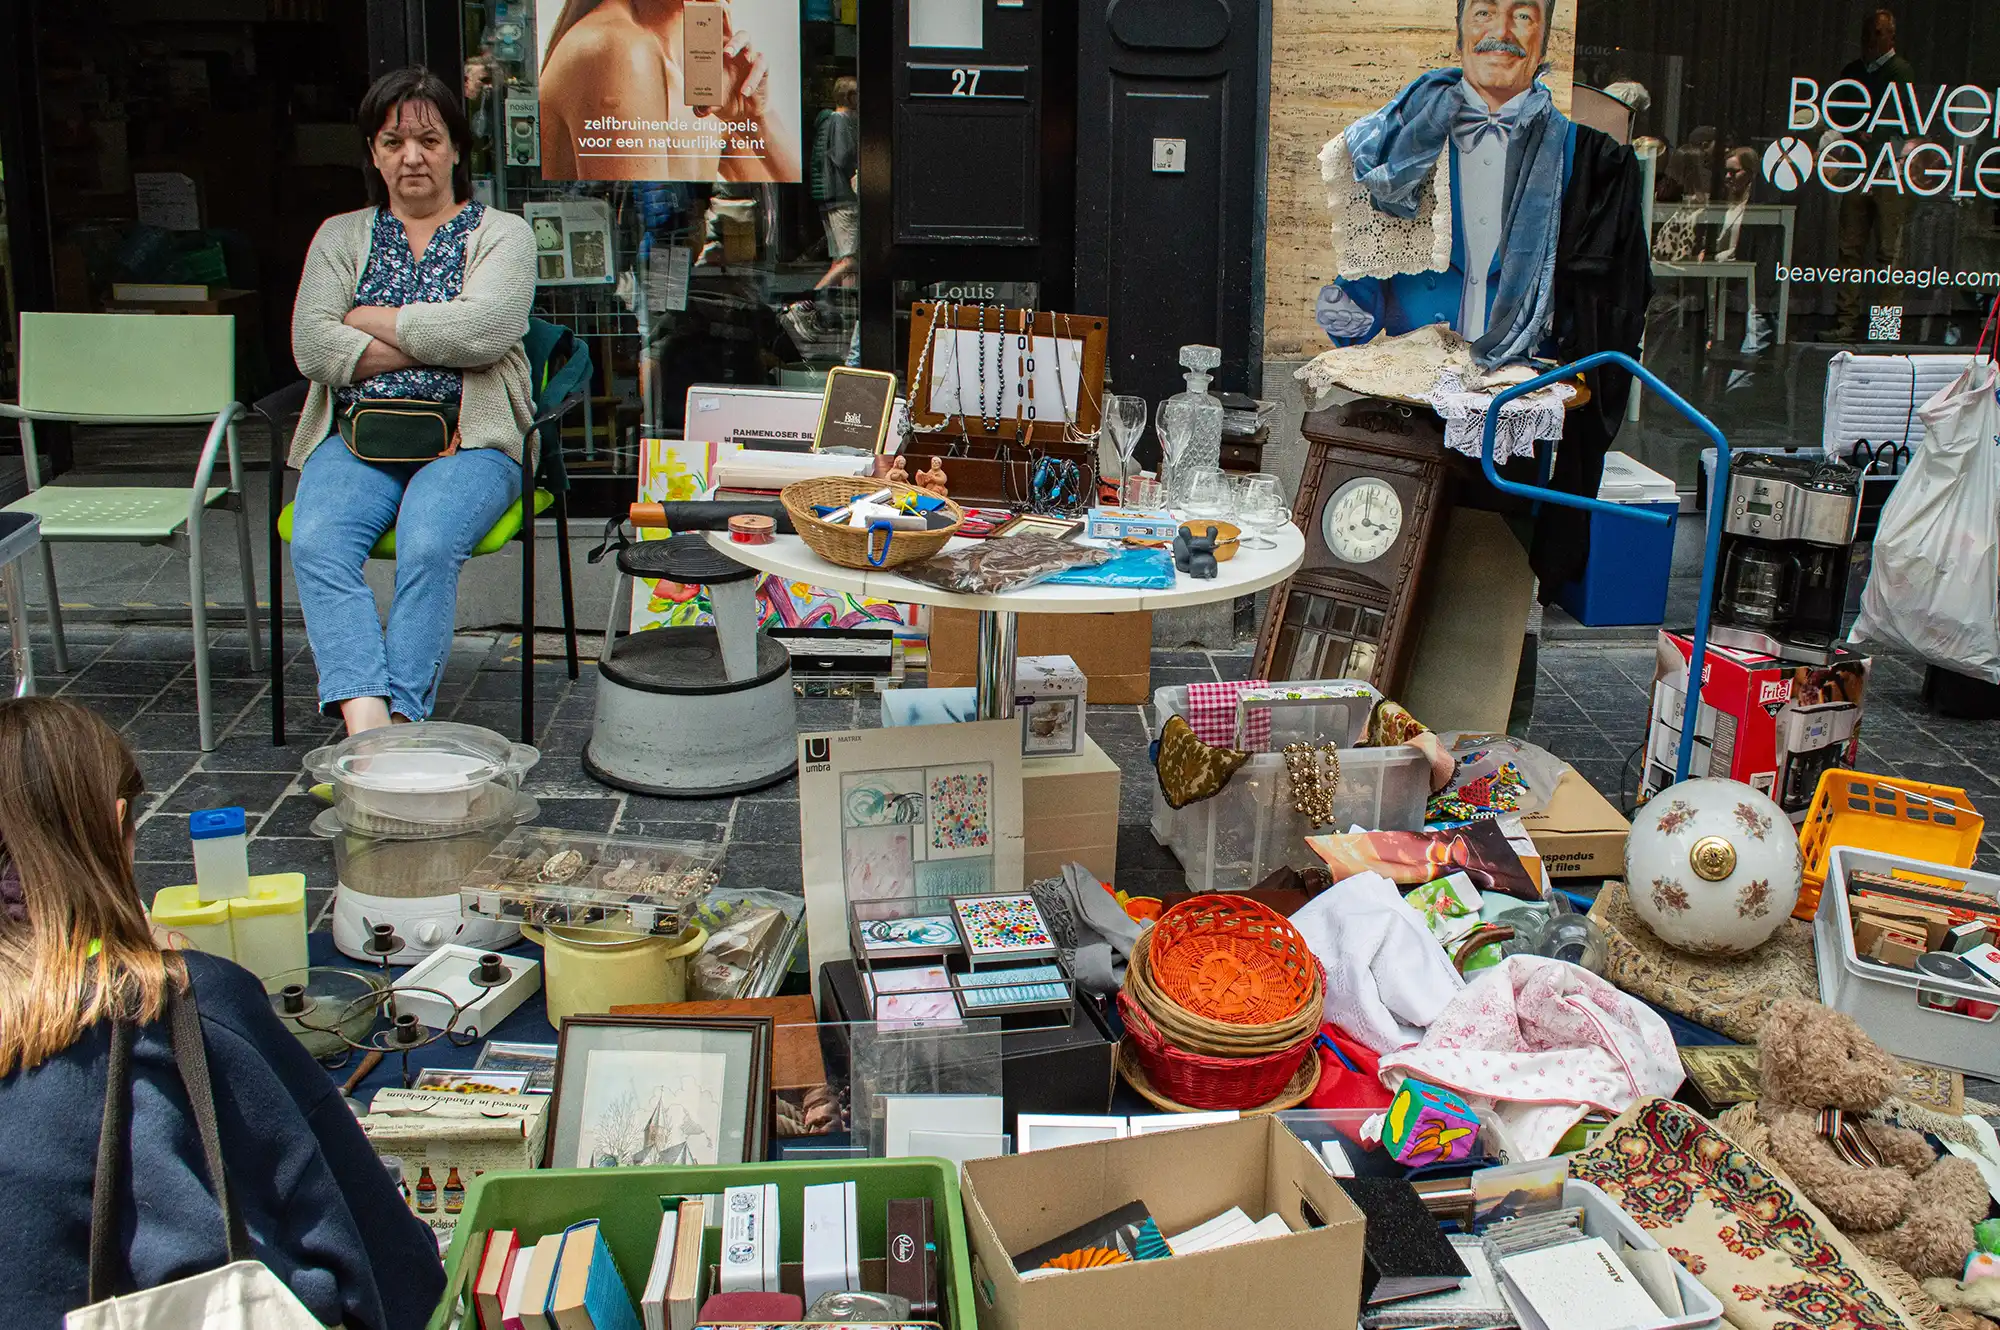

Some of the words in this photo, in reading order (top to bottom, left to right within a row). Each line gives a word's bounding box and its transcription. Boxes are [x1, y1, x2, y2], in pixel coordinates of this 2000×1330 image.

[952, 69, 980, 96] 27
[584, 116, 688, 132] zelfbruinende
[692, 118, 758, 134] druppels
[578, 137, 612, 149] voor
[616, 137, 644, 149] een
[648, 136, 727, 152] natuurlijke
[730, 136, 765, 150] teint
[1775, 261, 2000, 288] beaverandeagle.com
[935, 283, 995, 300] Louis
[733, 429, 799, 440] RAHMENLOSER
[801, 432, 817, 440] BIL
[1762, 683, 1790, 699] Fritel
[838, 735, 862, 743] MATRIX
[806, 763, 831, 773] umbra
[1556, 863, 1581, 872] files
[386, 1092, 475, 1106] Flanders/Belgium
[490, 1101, 530, 1111] Brewed
[1596, 1251, 1625, 1284] Album
